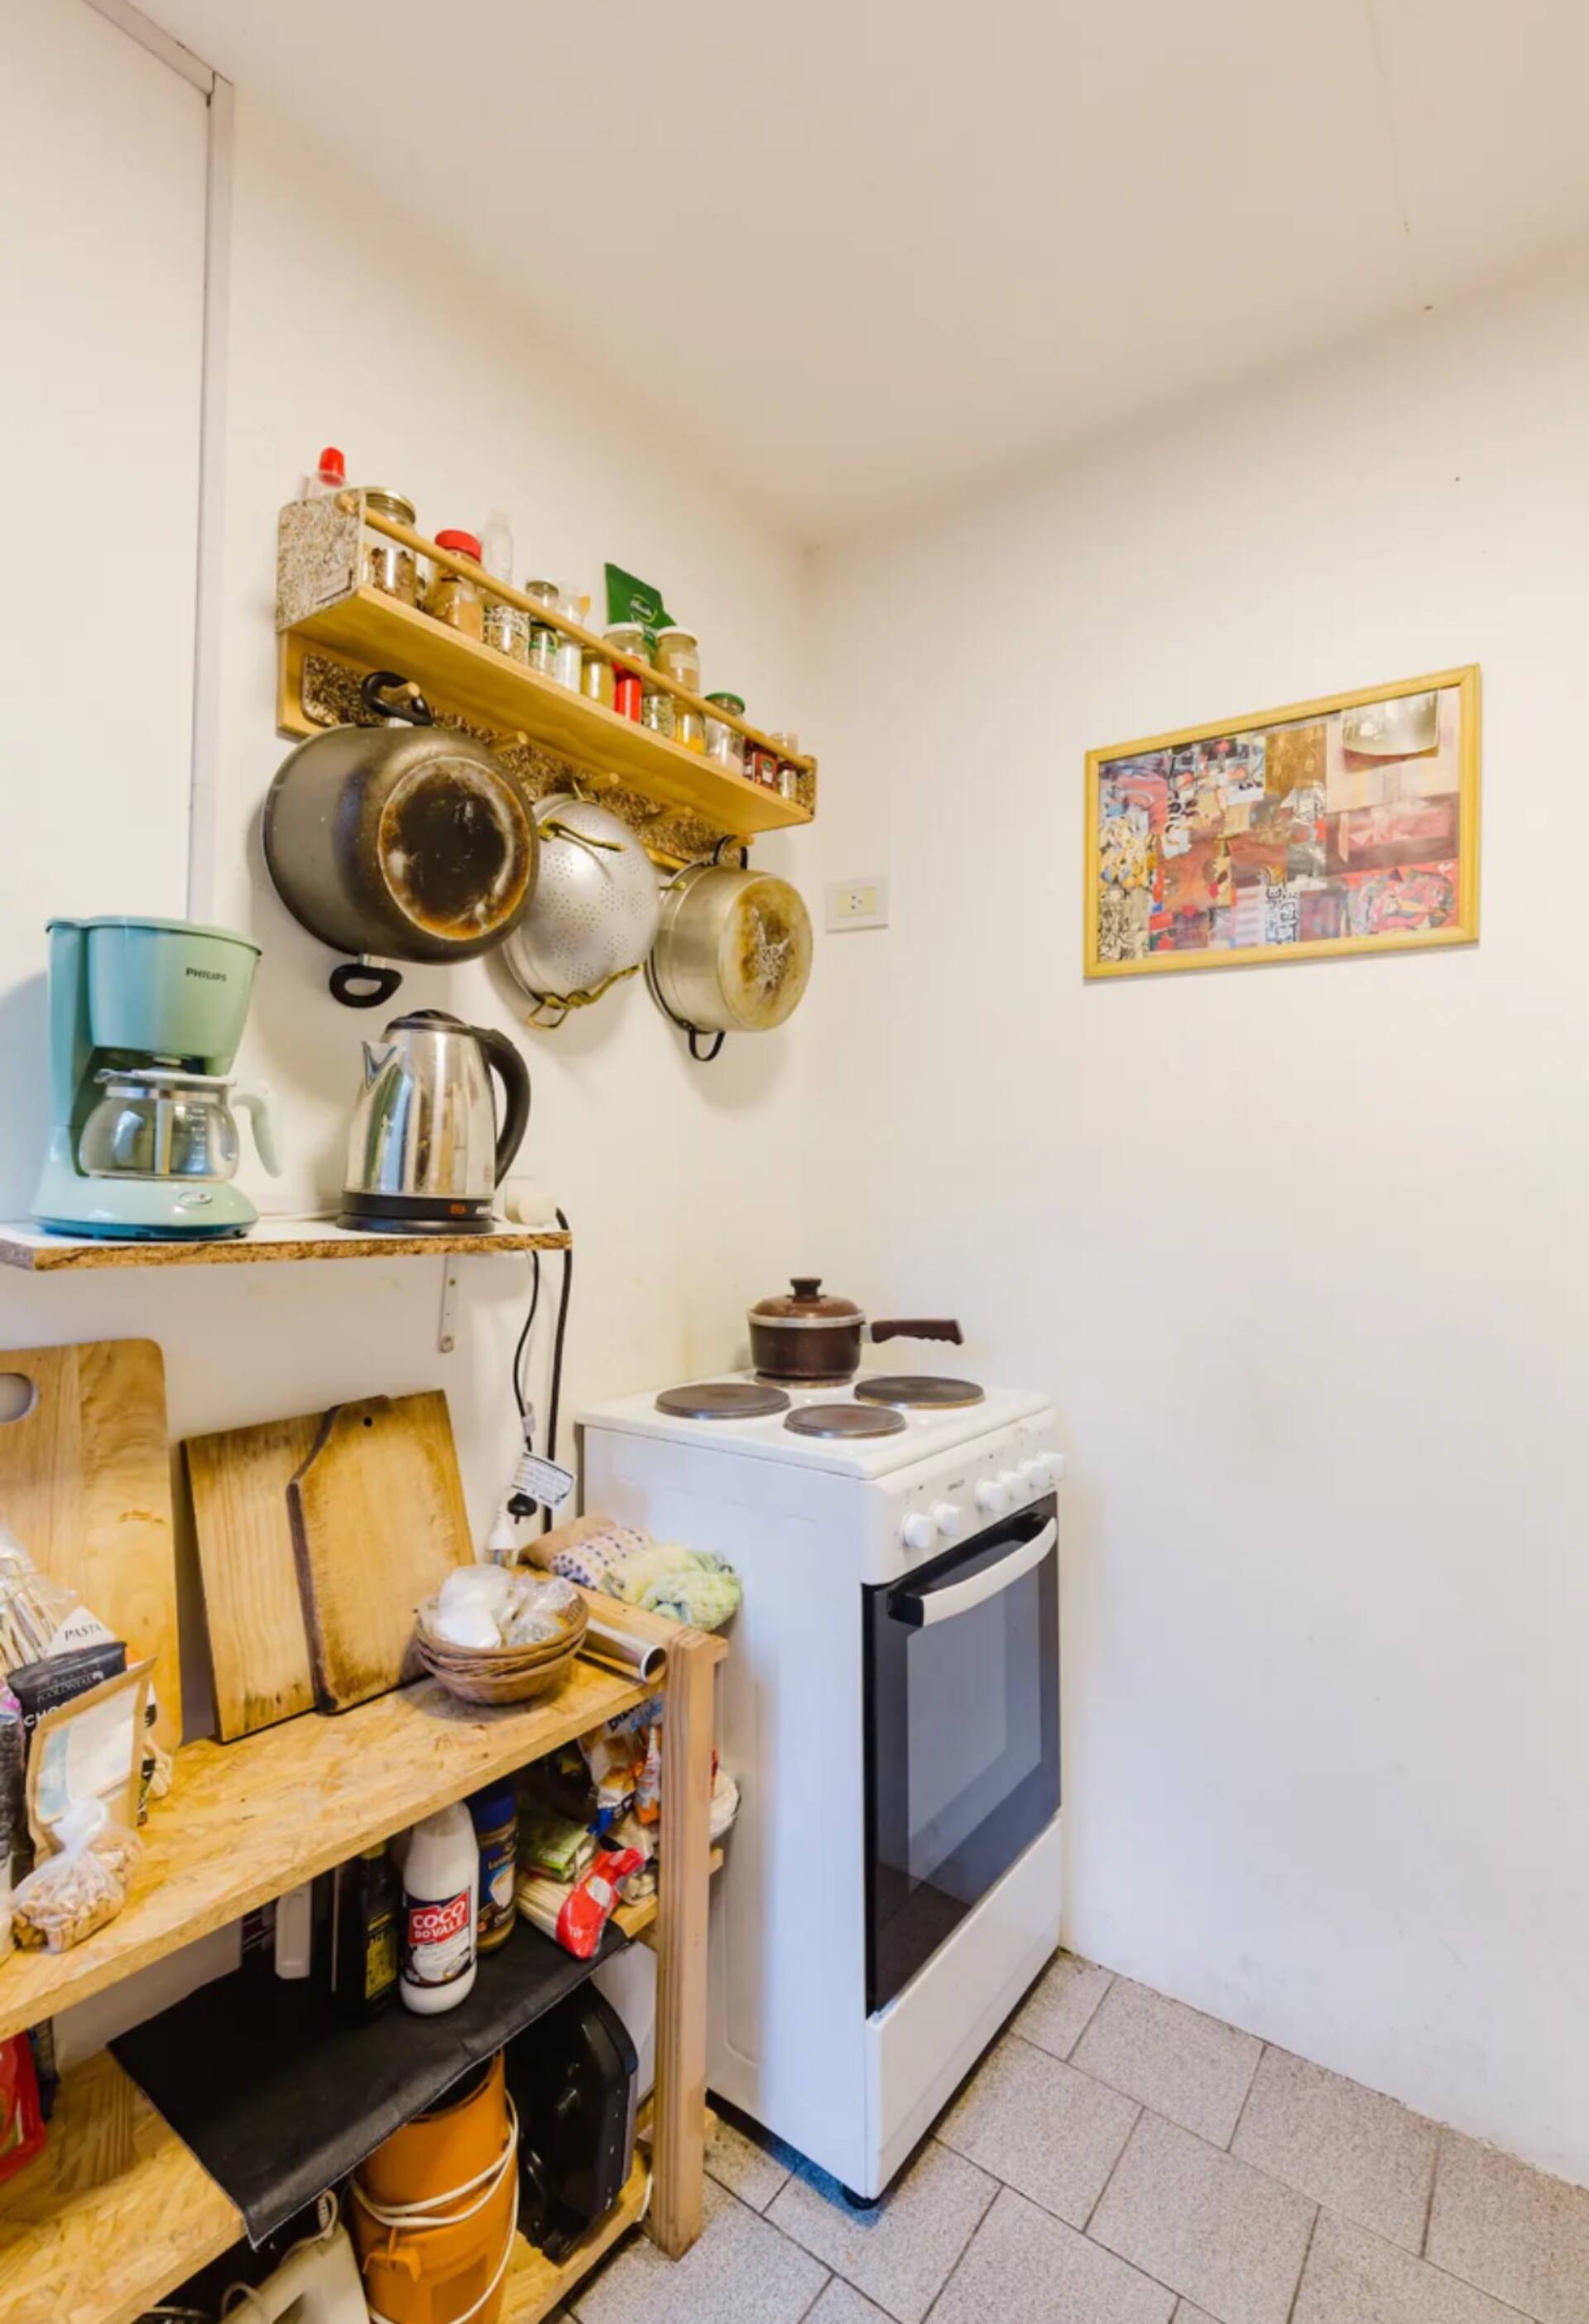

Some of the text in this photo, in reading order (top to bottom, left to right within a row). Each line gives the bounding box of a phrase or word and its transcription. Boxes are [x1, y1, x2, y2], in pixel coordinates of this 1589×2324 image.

[185, 967, 228, 982] PHILIPS
[64, 1622, 103, 1641] PASTA
[412, 1900, 466, 1928] COCO
[415, 1930, 430, 1938] DO
